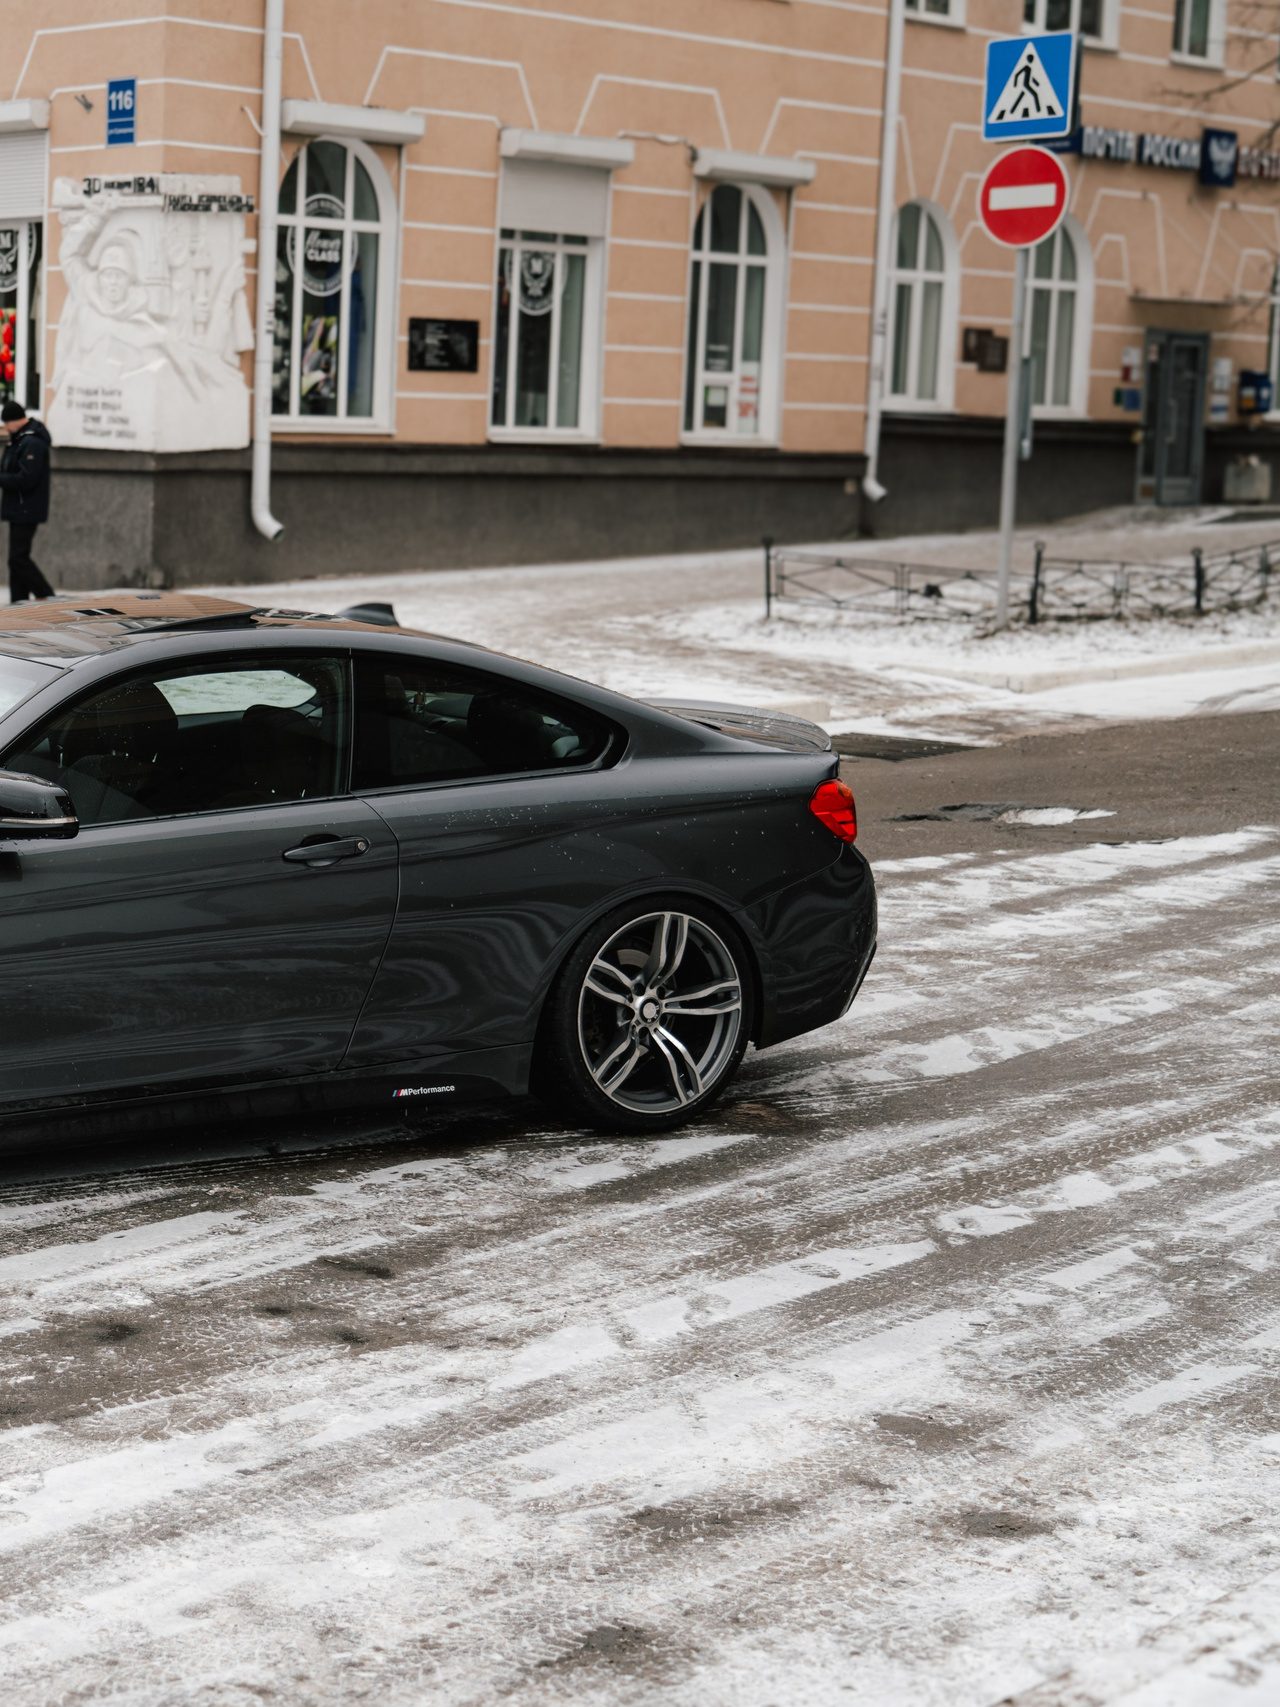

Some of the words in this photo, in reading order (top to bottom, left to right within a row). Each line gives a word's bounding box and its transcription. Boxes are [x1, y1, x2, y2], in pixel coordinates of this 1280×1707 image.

[109, 89, 134, 111] 116
[1081, 125, 1137, 163] ПОЧТА
[306, 248, 341, 263] CLASS
